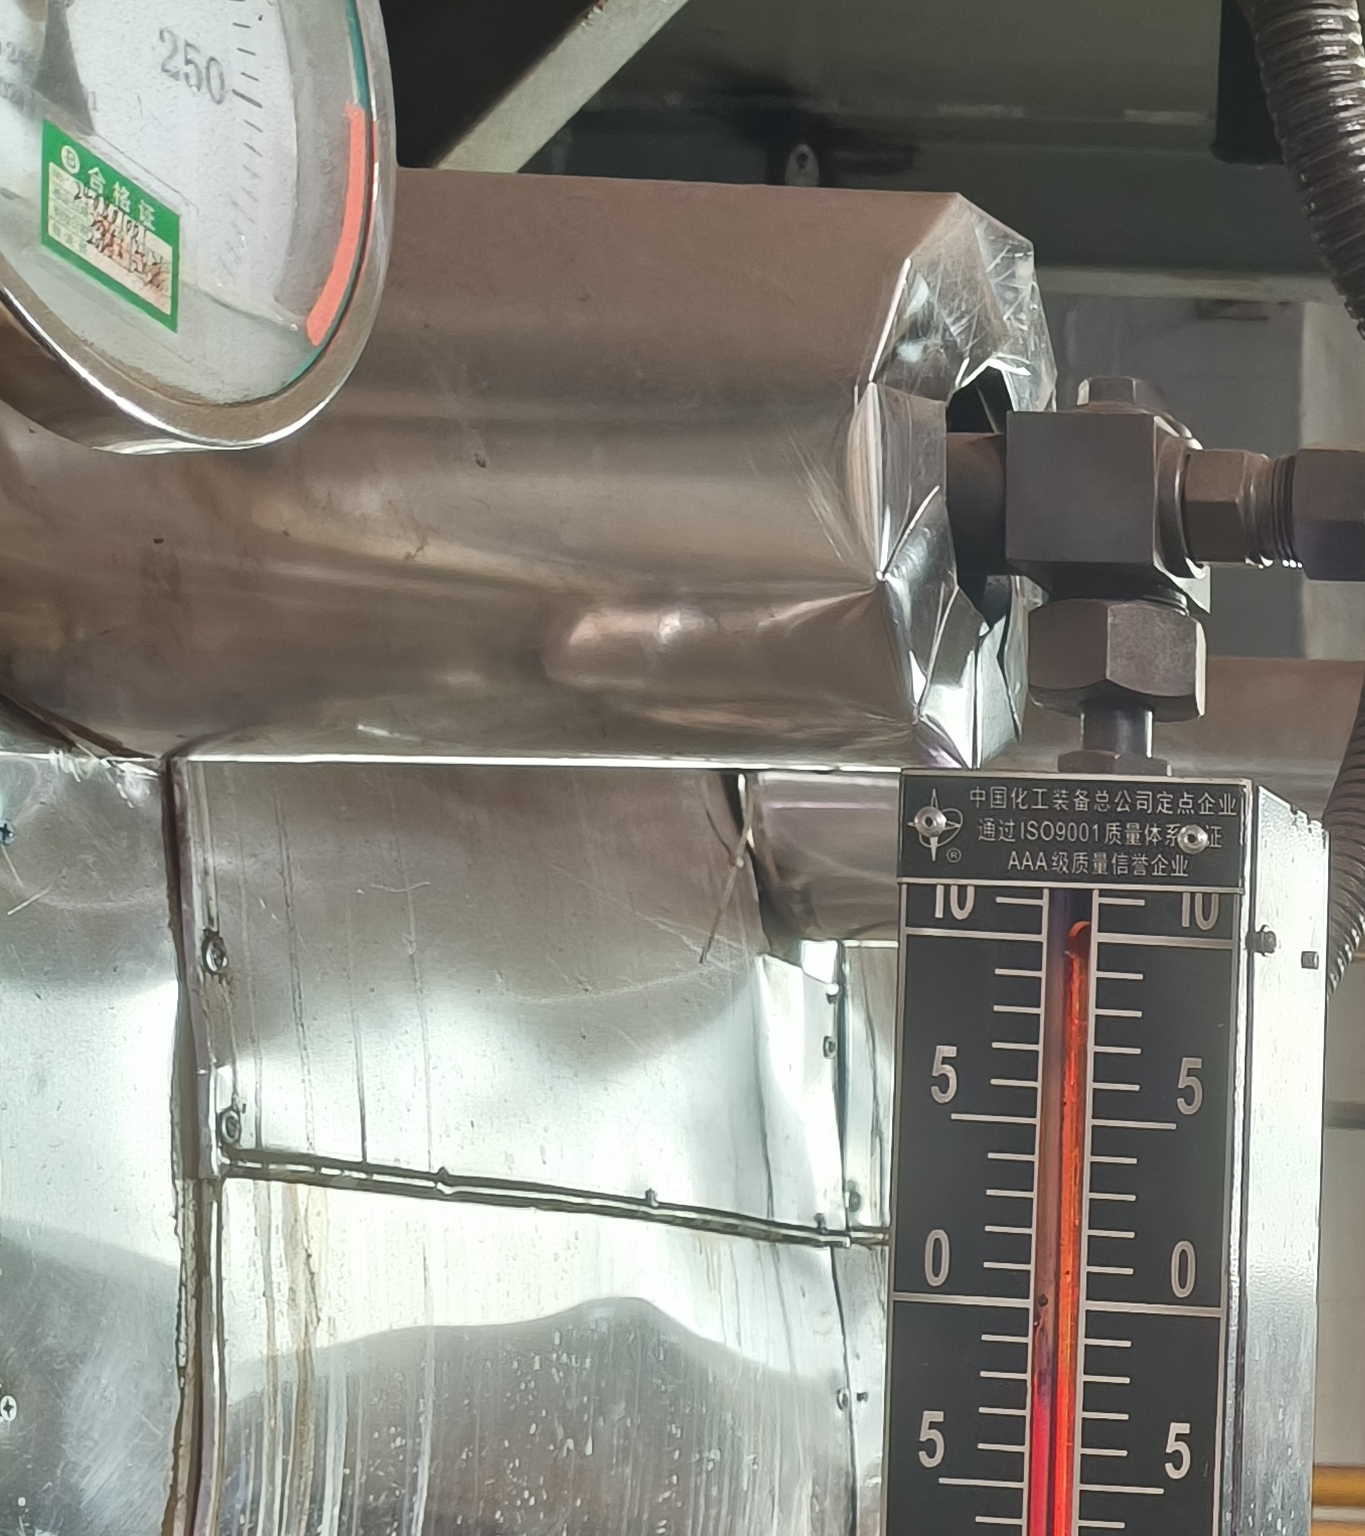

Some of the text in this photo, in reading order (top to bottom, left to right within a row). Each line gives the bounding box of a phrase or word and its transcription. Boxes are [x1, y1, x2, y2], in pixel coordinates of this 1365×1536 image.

[159, 27, 225, 105] 250
[88, 167, 156, 231] 合格证
[969, 786, 1237, 816] 中国化工装备总公司定点企业
[978, 817, 1223, 849] 通过ISO9001质量体系证
[1007, 850, 1189, 877] AAA级质量信誉企业
[930, 1045, 1203, 1116] 5 5
[924, 1229, 1196, 1299] 0 0
[917, 1410, 1191, 1480] 5 5
